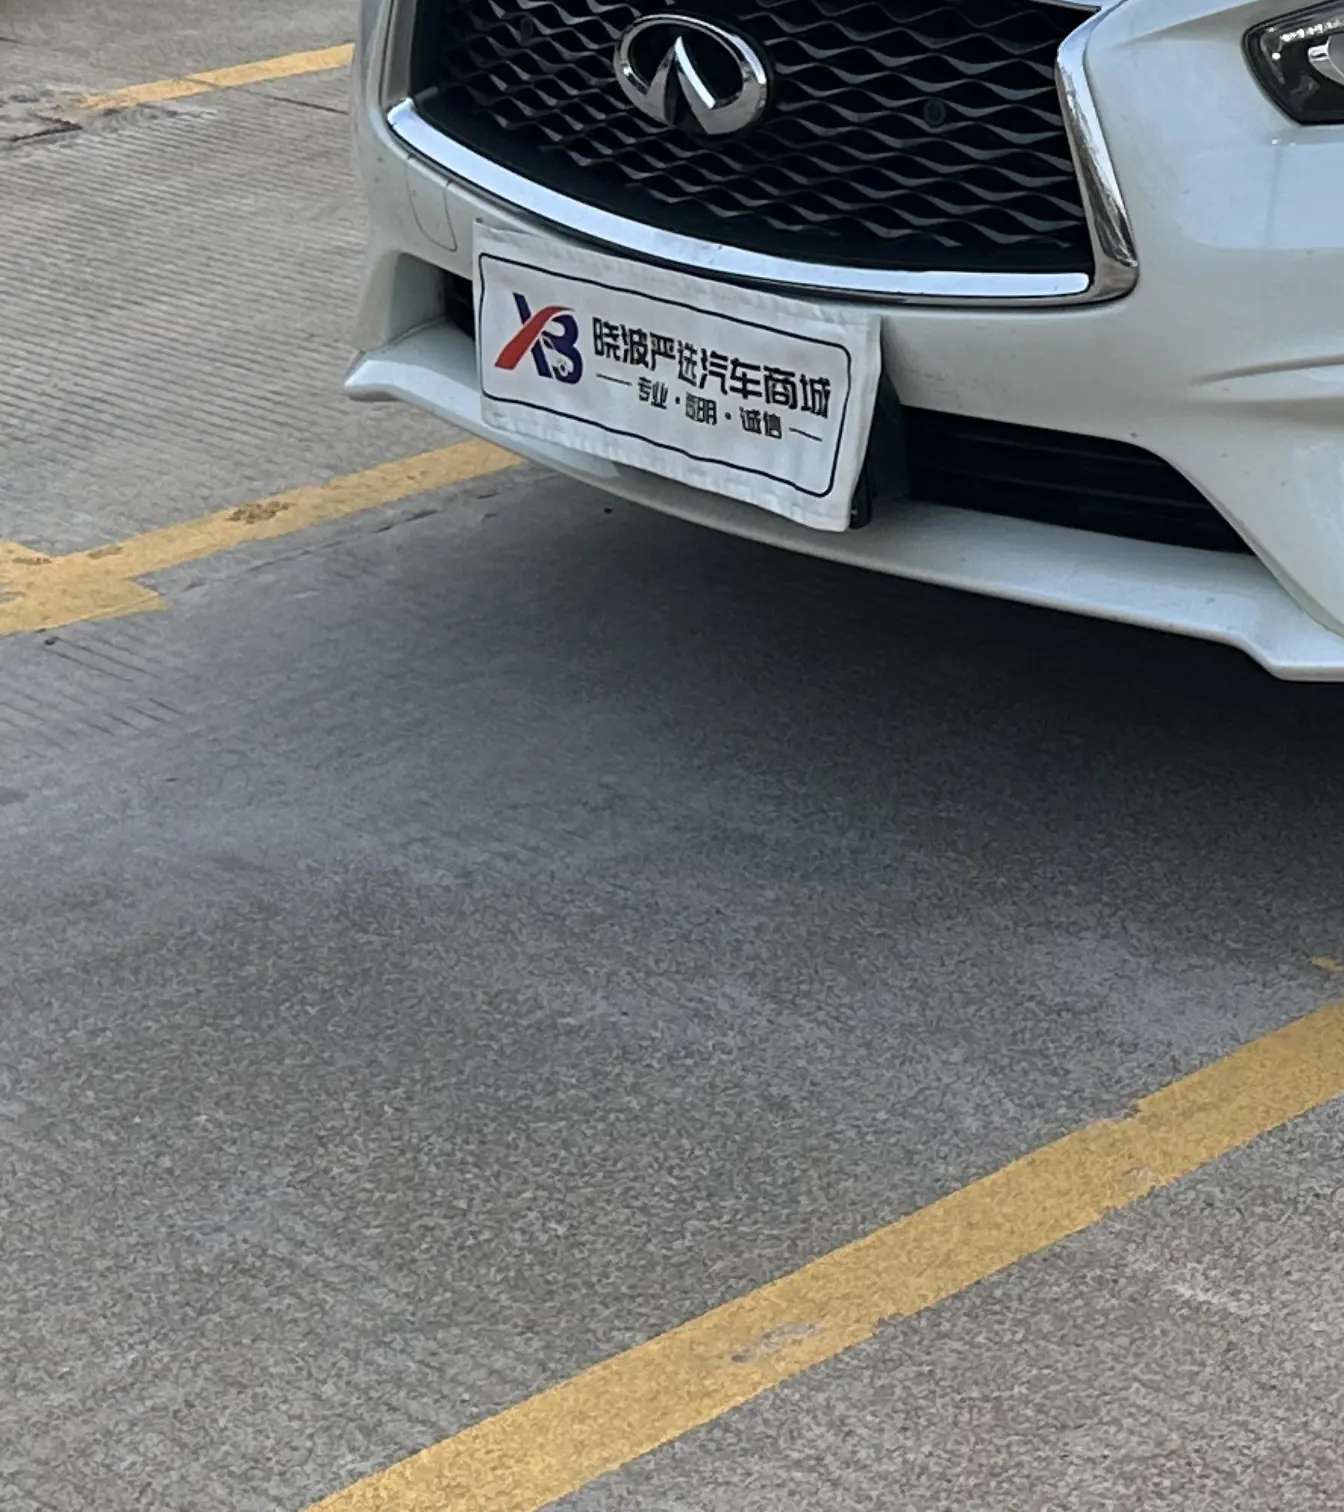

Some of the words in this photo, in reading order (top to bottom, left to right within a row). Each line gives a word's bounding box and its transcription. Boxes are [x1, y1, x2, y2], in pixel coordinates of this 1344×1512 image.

[592, 316, 831, 419] 晓波严选汽车商城
